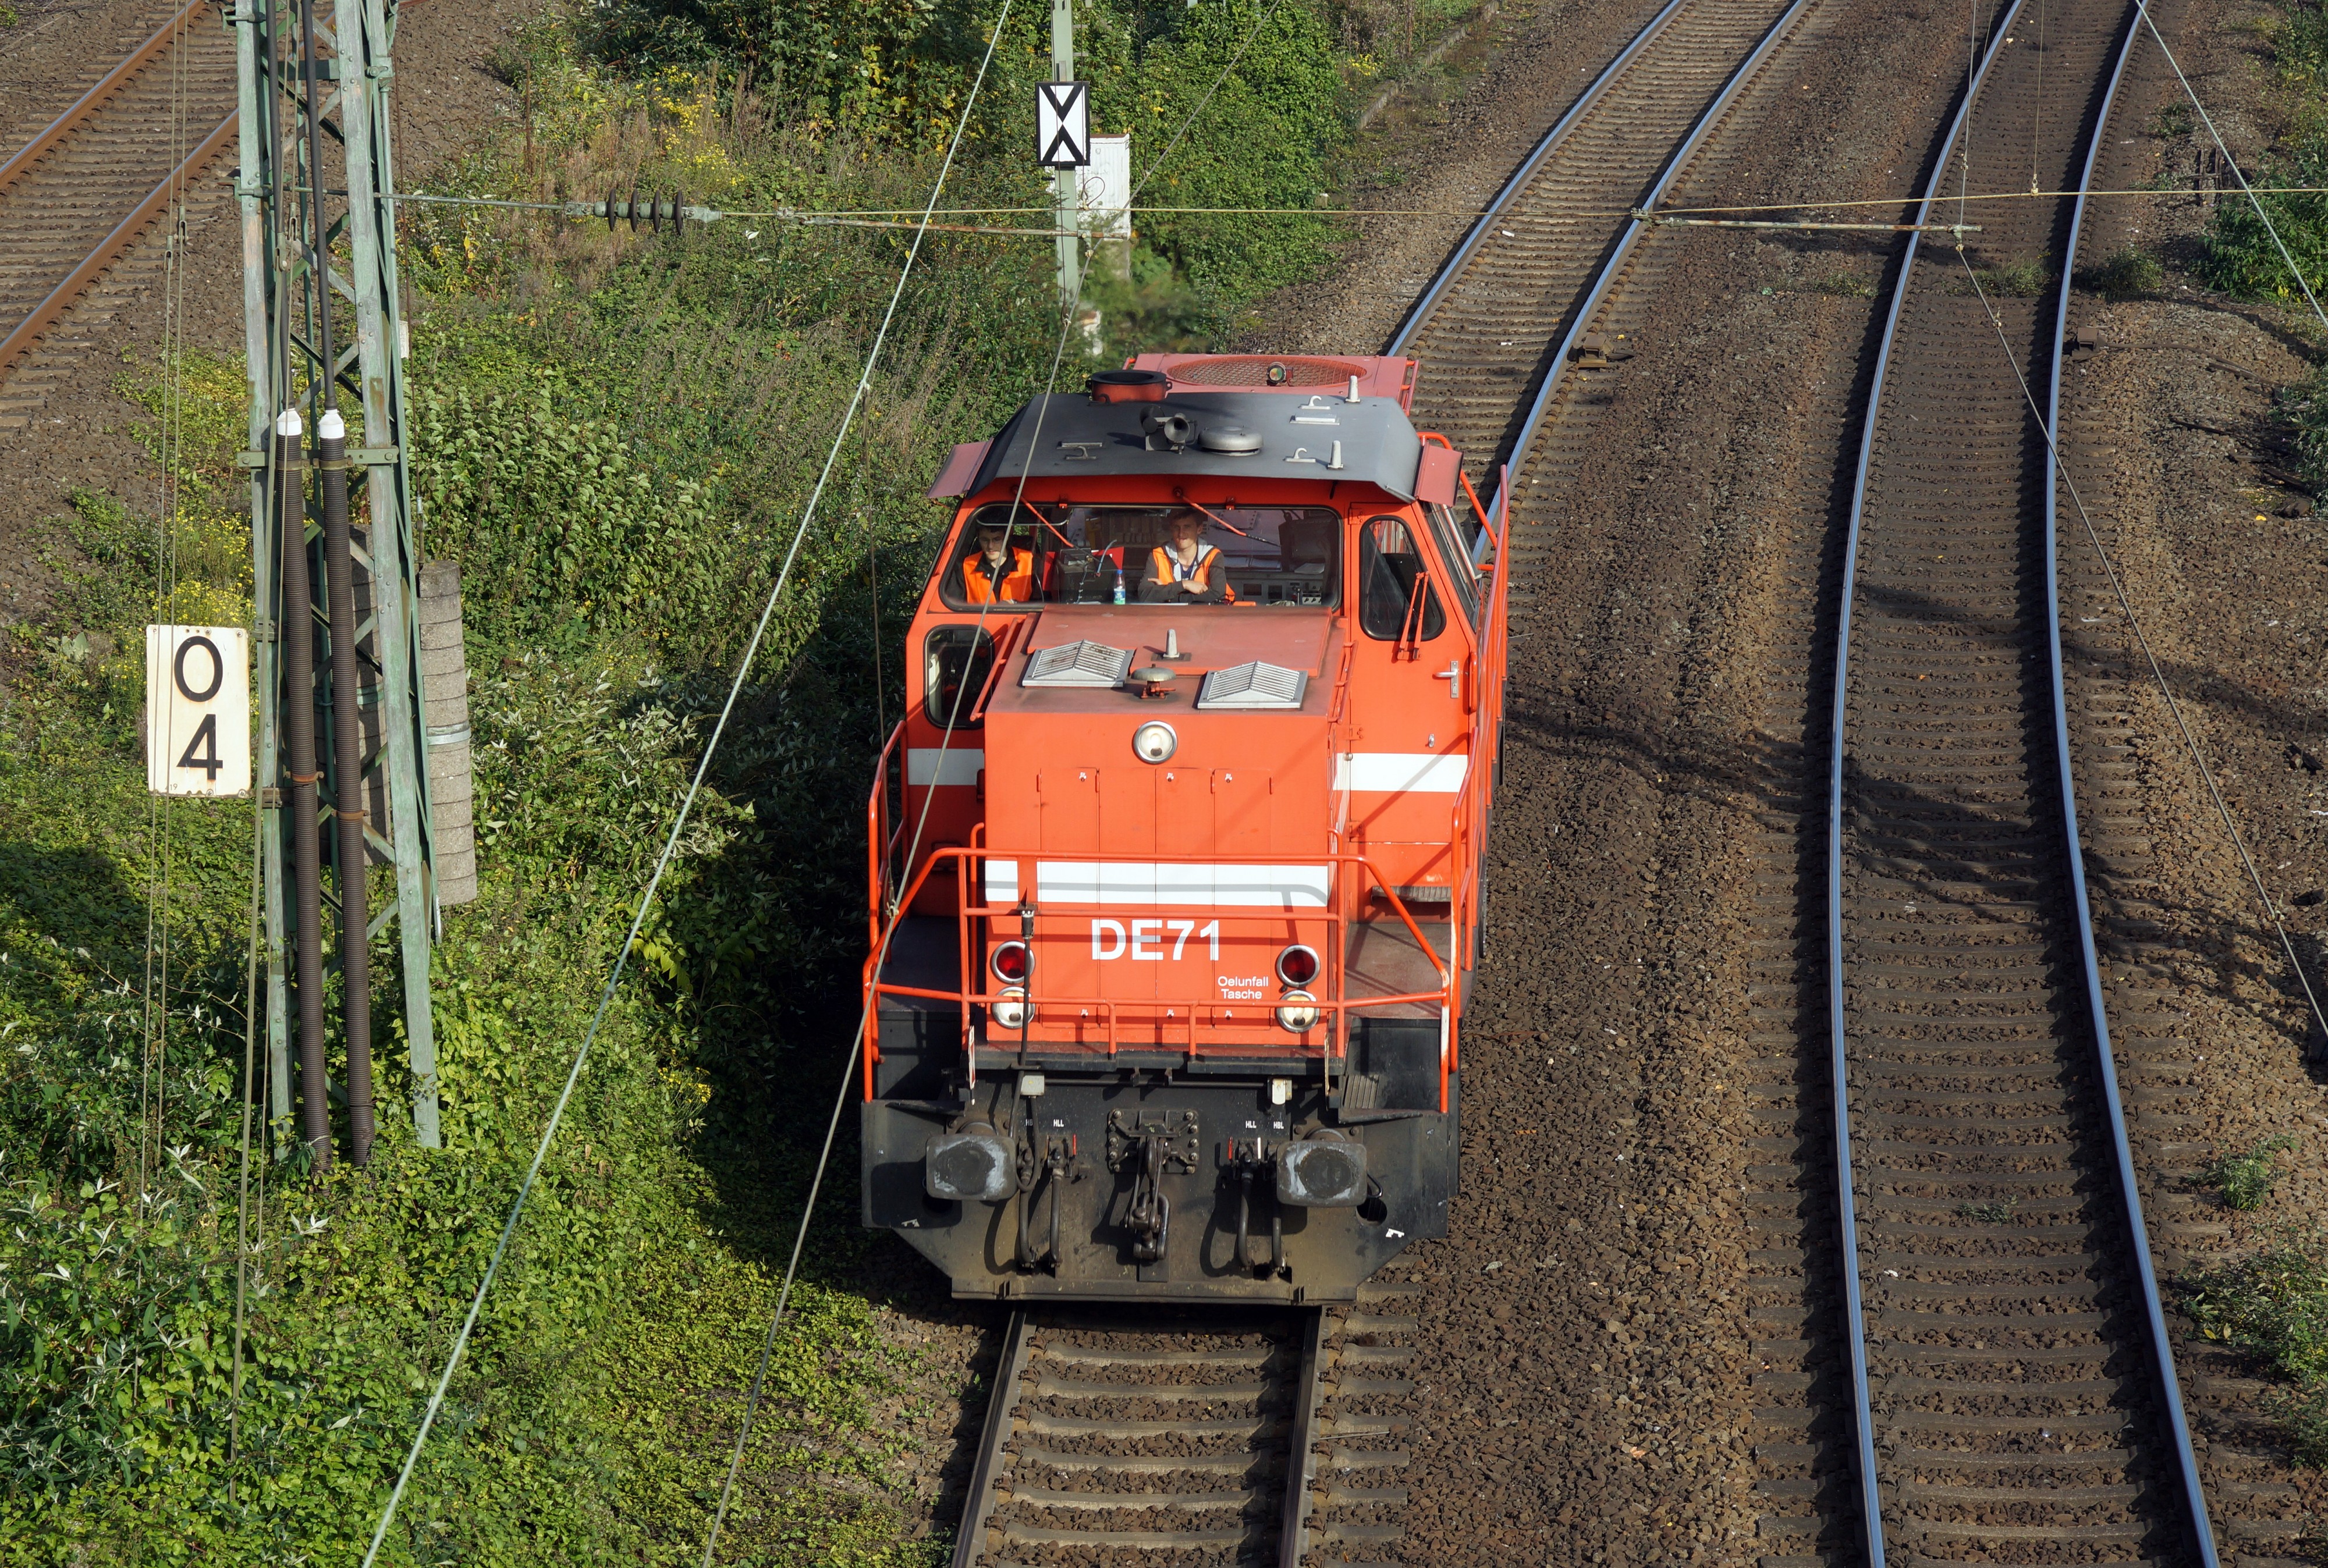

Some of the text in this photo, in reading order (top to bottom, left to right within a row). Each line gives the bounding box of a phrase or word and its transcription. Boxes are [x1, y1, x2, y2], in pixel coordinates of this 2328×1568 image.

[176, 714, 223, 780] 4
[1092, 919, 1219, 961] DE71
[1218, 976, 1269, 987] Oelunfall
[1220, 989, 1262, 999] Tasche
[1053, 1119, 1064, 1127] HLL
[1245, 1121, 1257, 1129] HLL
[1273, 1121, 1284, 1129] HBL
